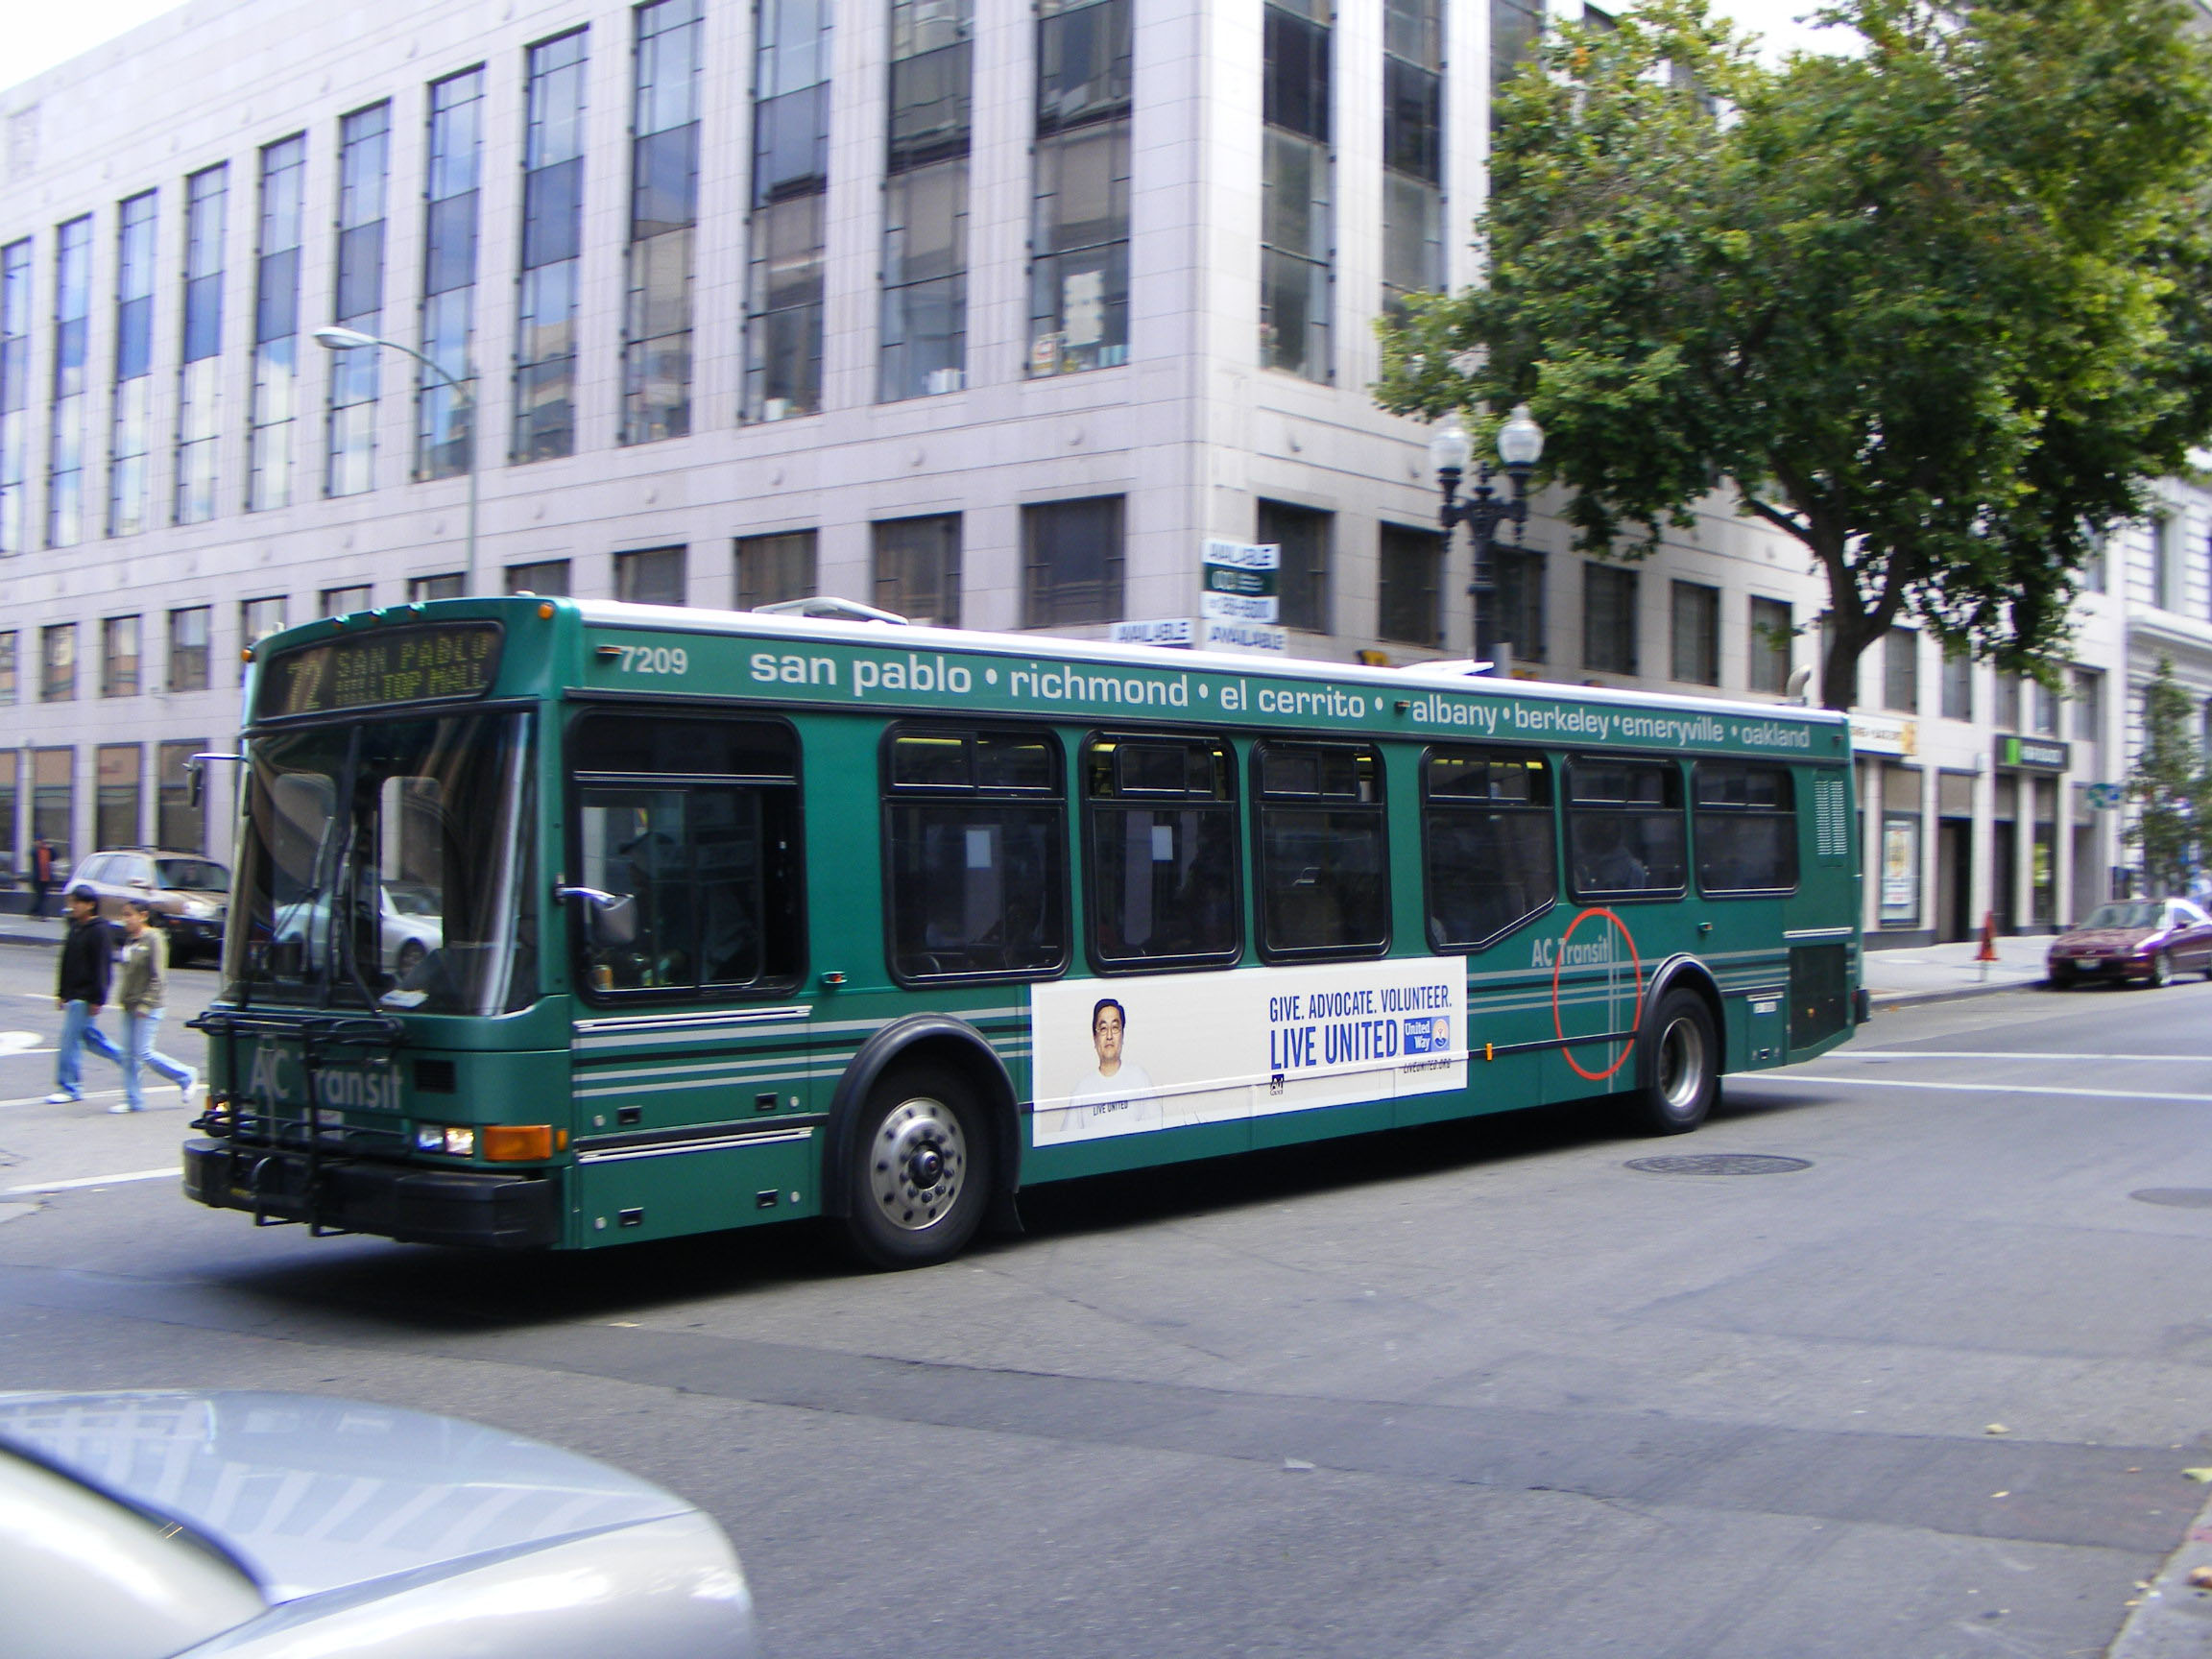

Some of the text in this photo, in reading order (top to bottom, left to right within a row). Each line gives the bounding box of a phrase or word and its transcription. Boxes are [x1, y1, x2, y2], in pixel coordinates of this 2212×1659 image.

[338, 631, 489, 678] SAN PABLO
[619, 645, 688, 674] 7209
[287, 658, 324, 711] 72
[749, 654, 836, 685] san
[854, 654, 972, 696] pablo
[1010, 663, 1189, 708] richmond
[1220, 679, 1247, 710] el
[1258, 685, 1365, 719] cerrito
[1412, 695, 1498, 735] albany
[1514, 702, 1609, 740] berkeley
[1622, 715, 1724, 746] emeryville
[1741, 724, 1811, 748] oakland
[1531, 933, 1611, 968] AC Transit
[1269, 984, 1453, 1022] GIVE. ADVOCATE. VOLUNTEER.
[1270, 1019, 1398, 1070] LIVE UNITED
[1405, 1021, 1431, 1036] United
[1413, 1034, 1431, 1052] Way
[1093, 1099, 1129, 1117] LIVE UNITED
